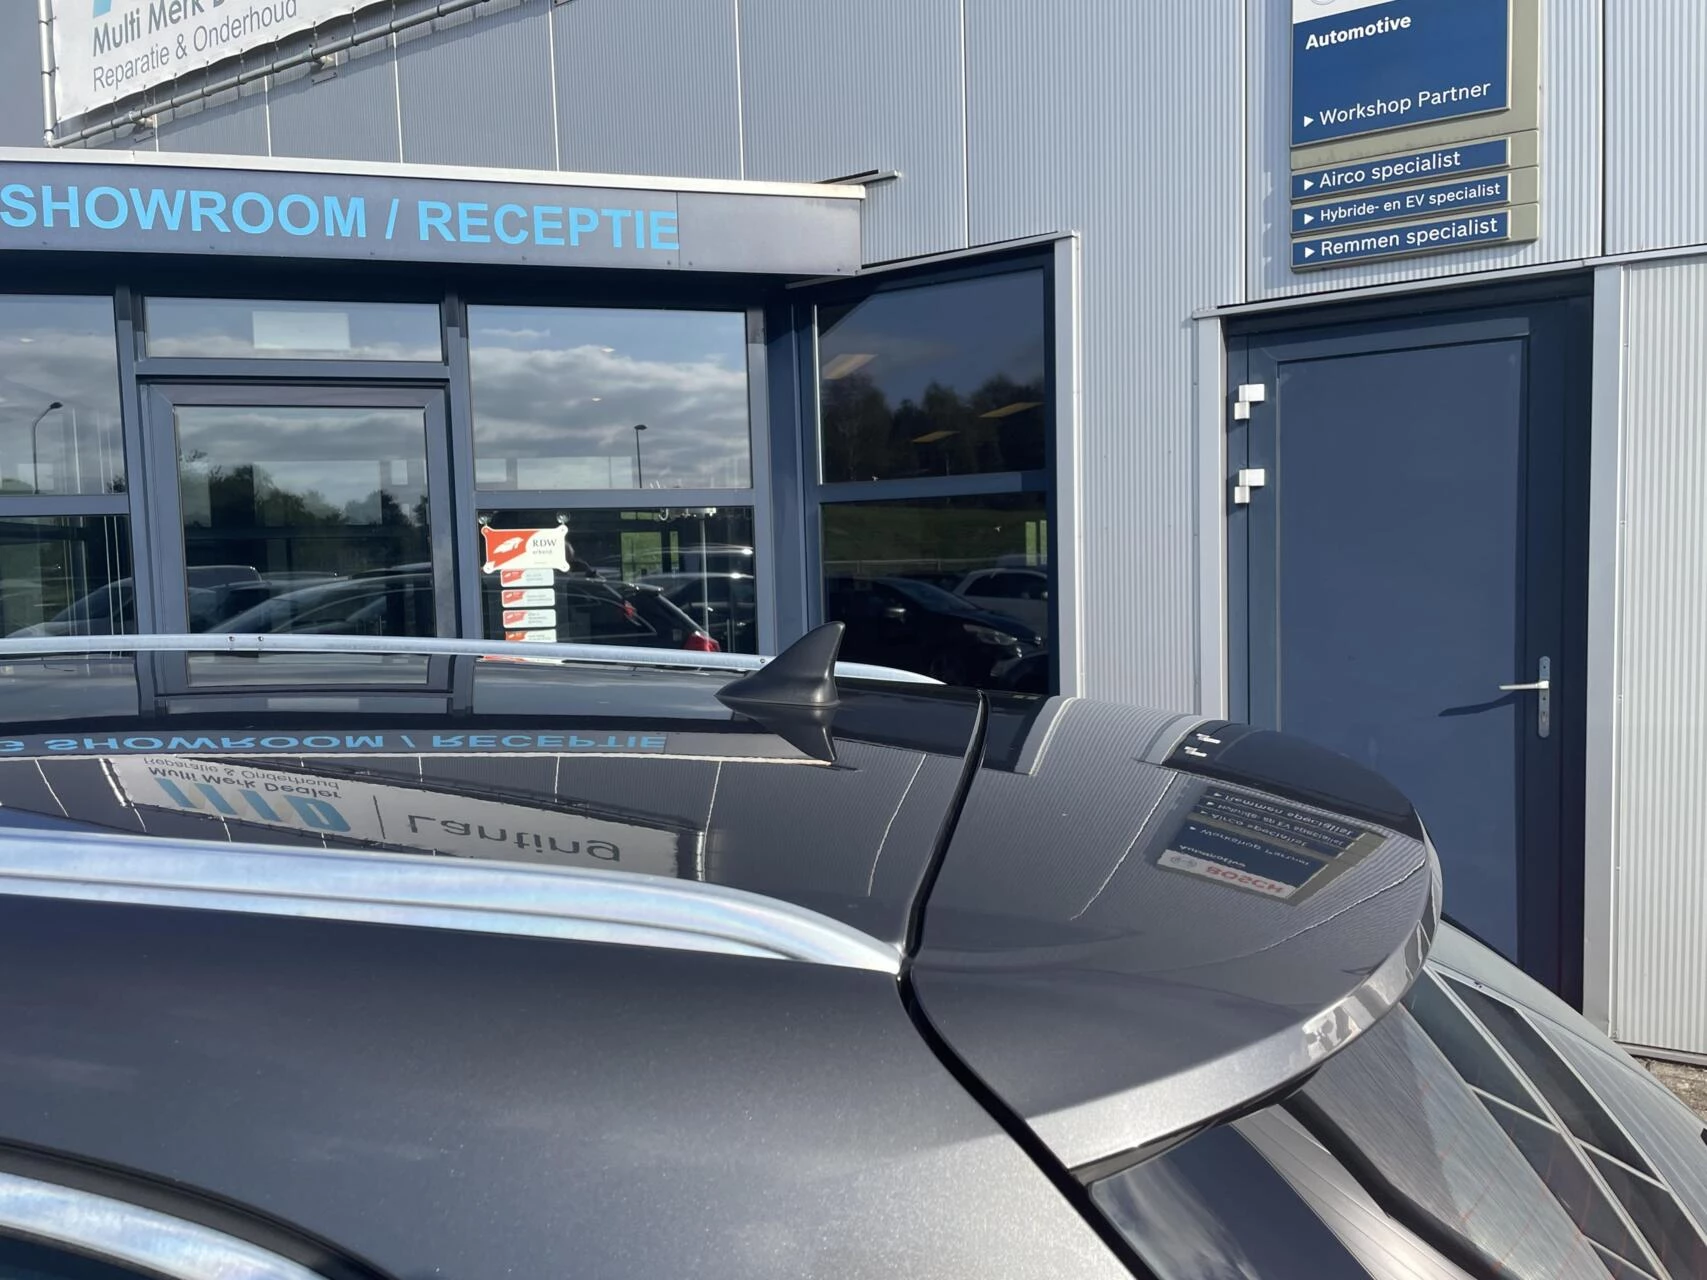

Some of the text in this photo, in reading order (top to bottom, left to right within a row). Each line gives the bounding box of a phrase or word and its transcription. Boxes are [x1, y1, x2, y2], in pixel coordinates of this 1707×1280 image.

[93, 8, 141, 57] Multi
[93, 0, 297, 92] Reparatie & Onderhoud
[1305, 16, 1412, 50] Automotive
[1319, 82, 1492, 126] Workshop Partner
[1319, 151, 1461, 189] Airco specialist
[0, 183, 680, 250] SHOWROOM / RECEPTIE
[1320, 182, 1501, 223] Hybride- en EV specialist
[1321, 217, 1498, 257] Remmen specialist
[532, 539, 557, 547] RDW
